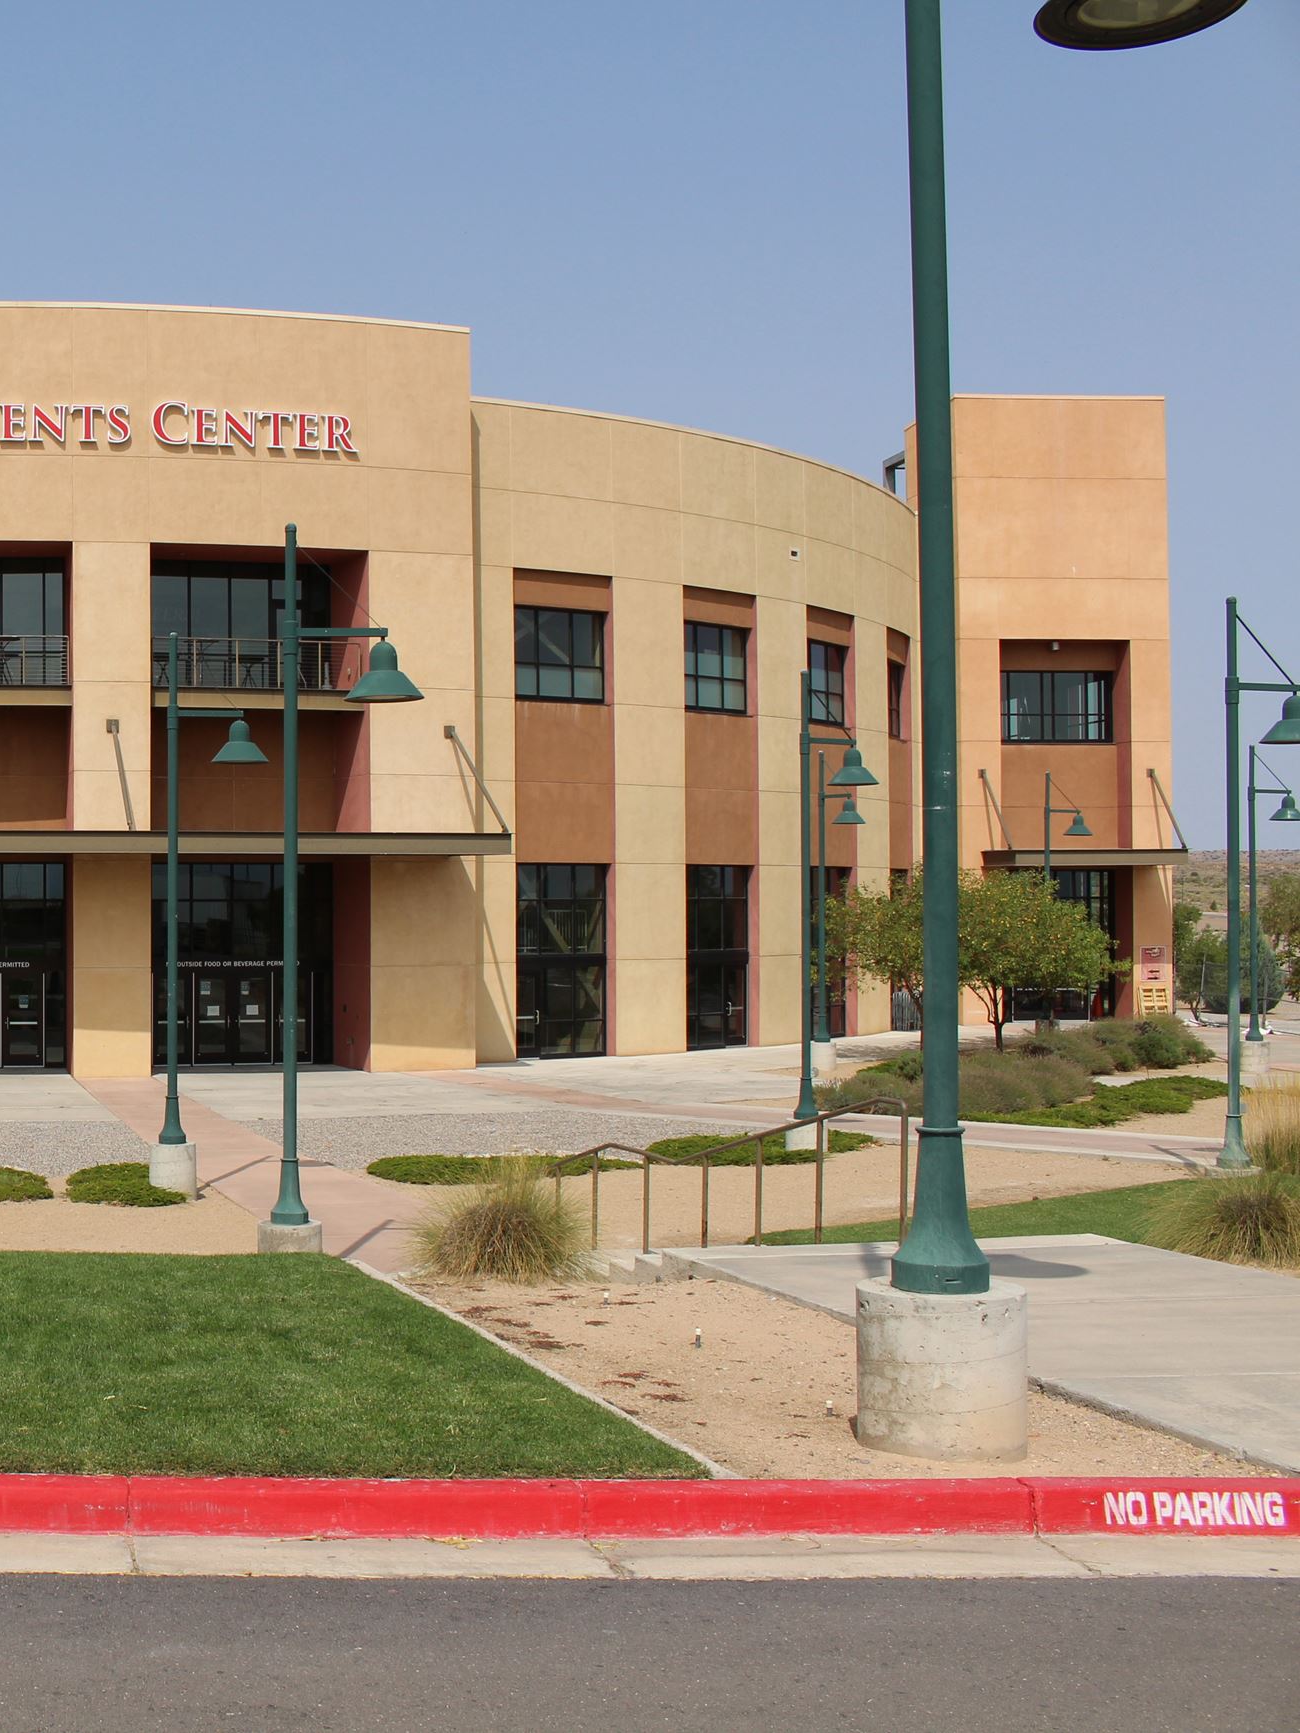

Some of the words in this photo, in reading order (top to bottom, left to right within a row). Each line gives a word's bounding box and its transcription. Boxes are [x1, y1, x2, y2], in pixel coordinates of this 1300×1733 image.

[151, 401, 359, 452] CENTER
[1103, 1491, 1148, 1525] NO
[1153, 1491, 1286, 1526] PARKING
